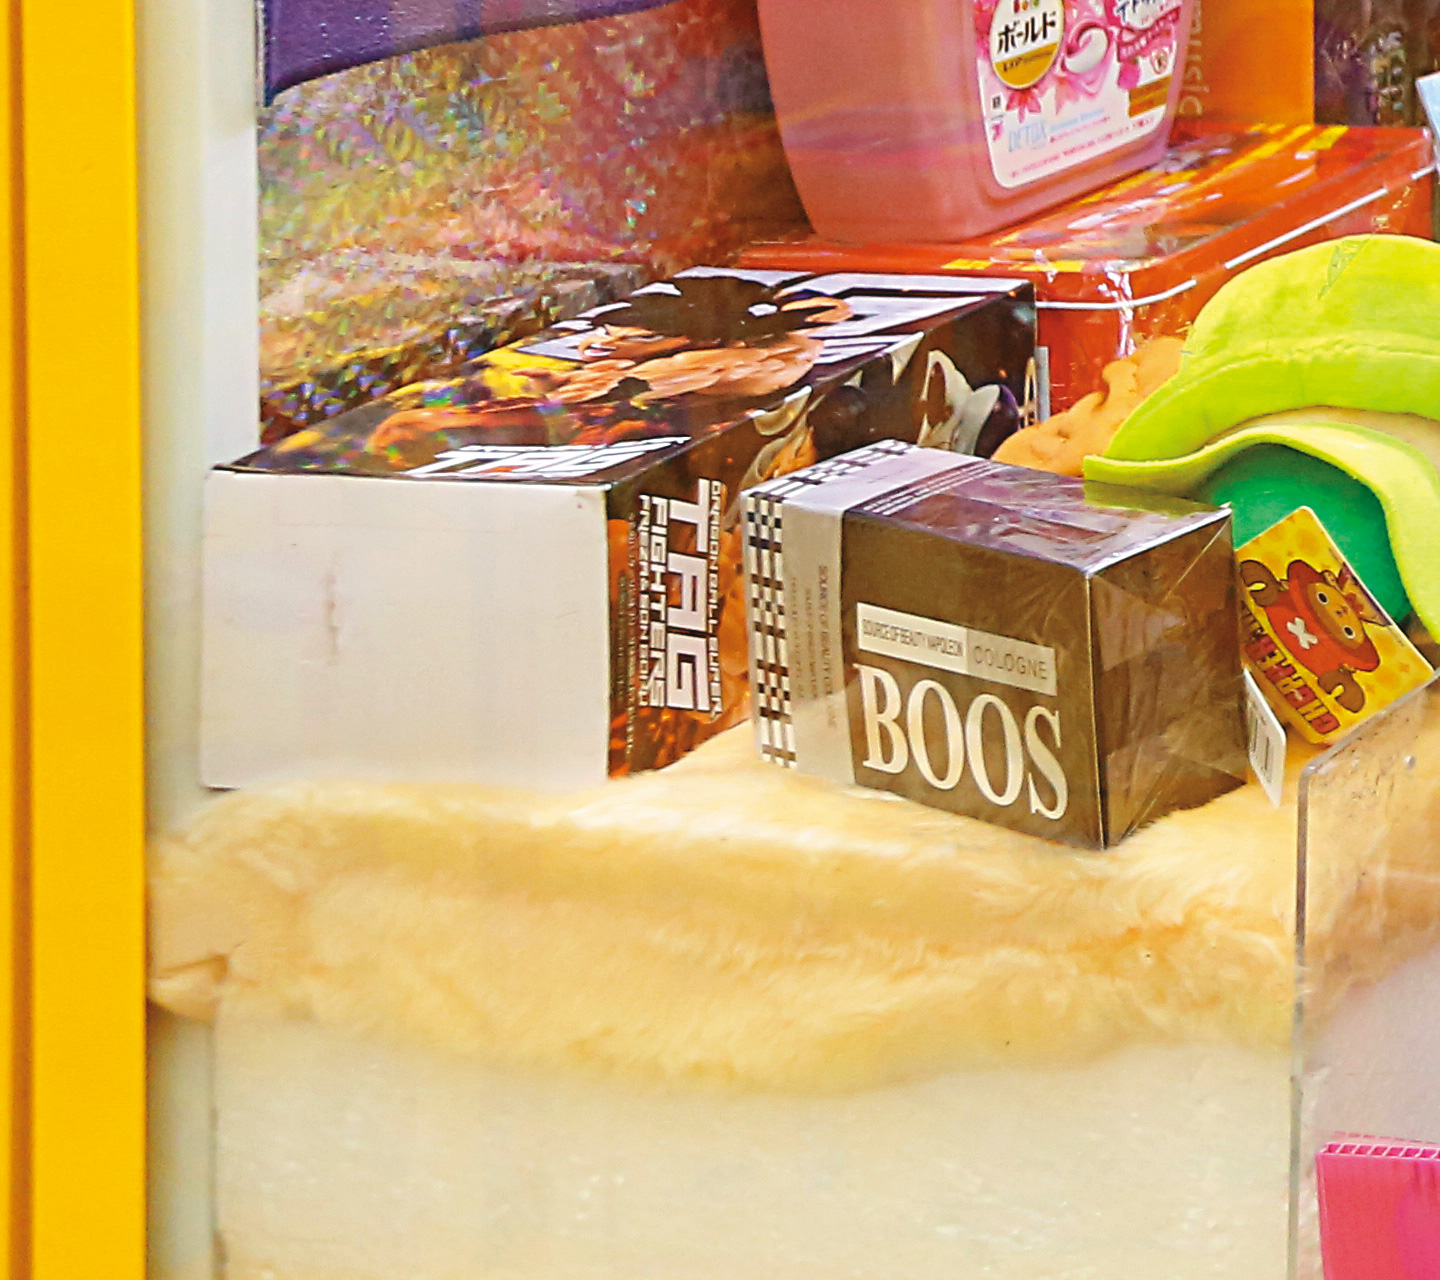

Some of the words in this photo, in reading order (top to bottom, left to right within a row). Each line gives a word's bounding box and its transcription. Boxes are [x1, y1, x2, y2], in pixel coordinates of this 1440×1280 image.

[996, 11, 1058, 55] ボールド
[649, 496, 668, 708] FIGHTERS
[666, 477, 712, 712] TAG
[974, 644, 1049, 681] COLOGNE
[852, 662, 1069, 821] BOOS
